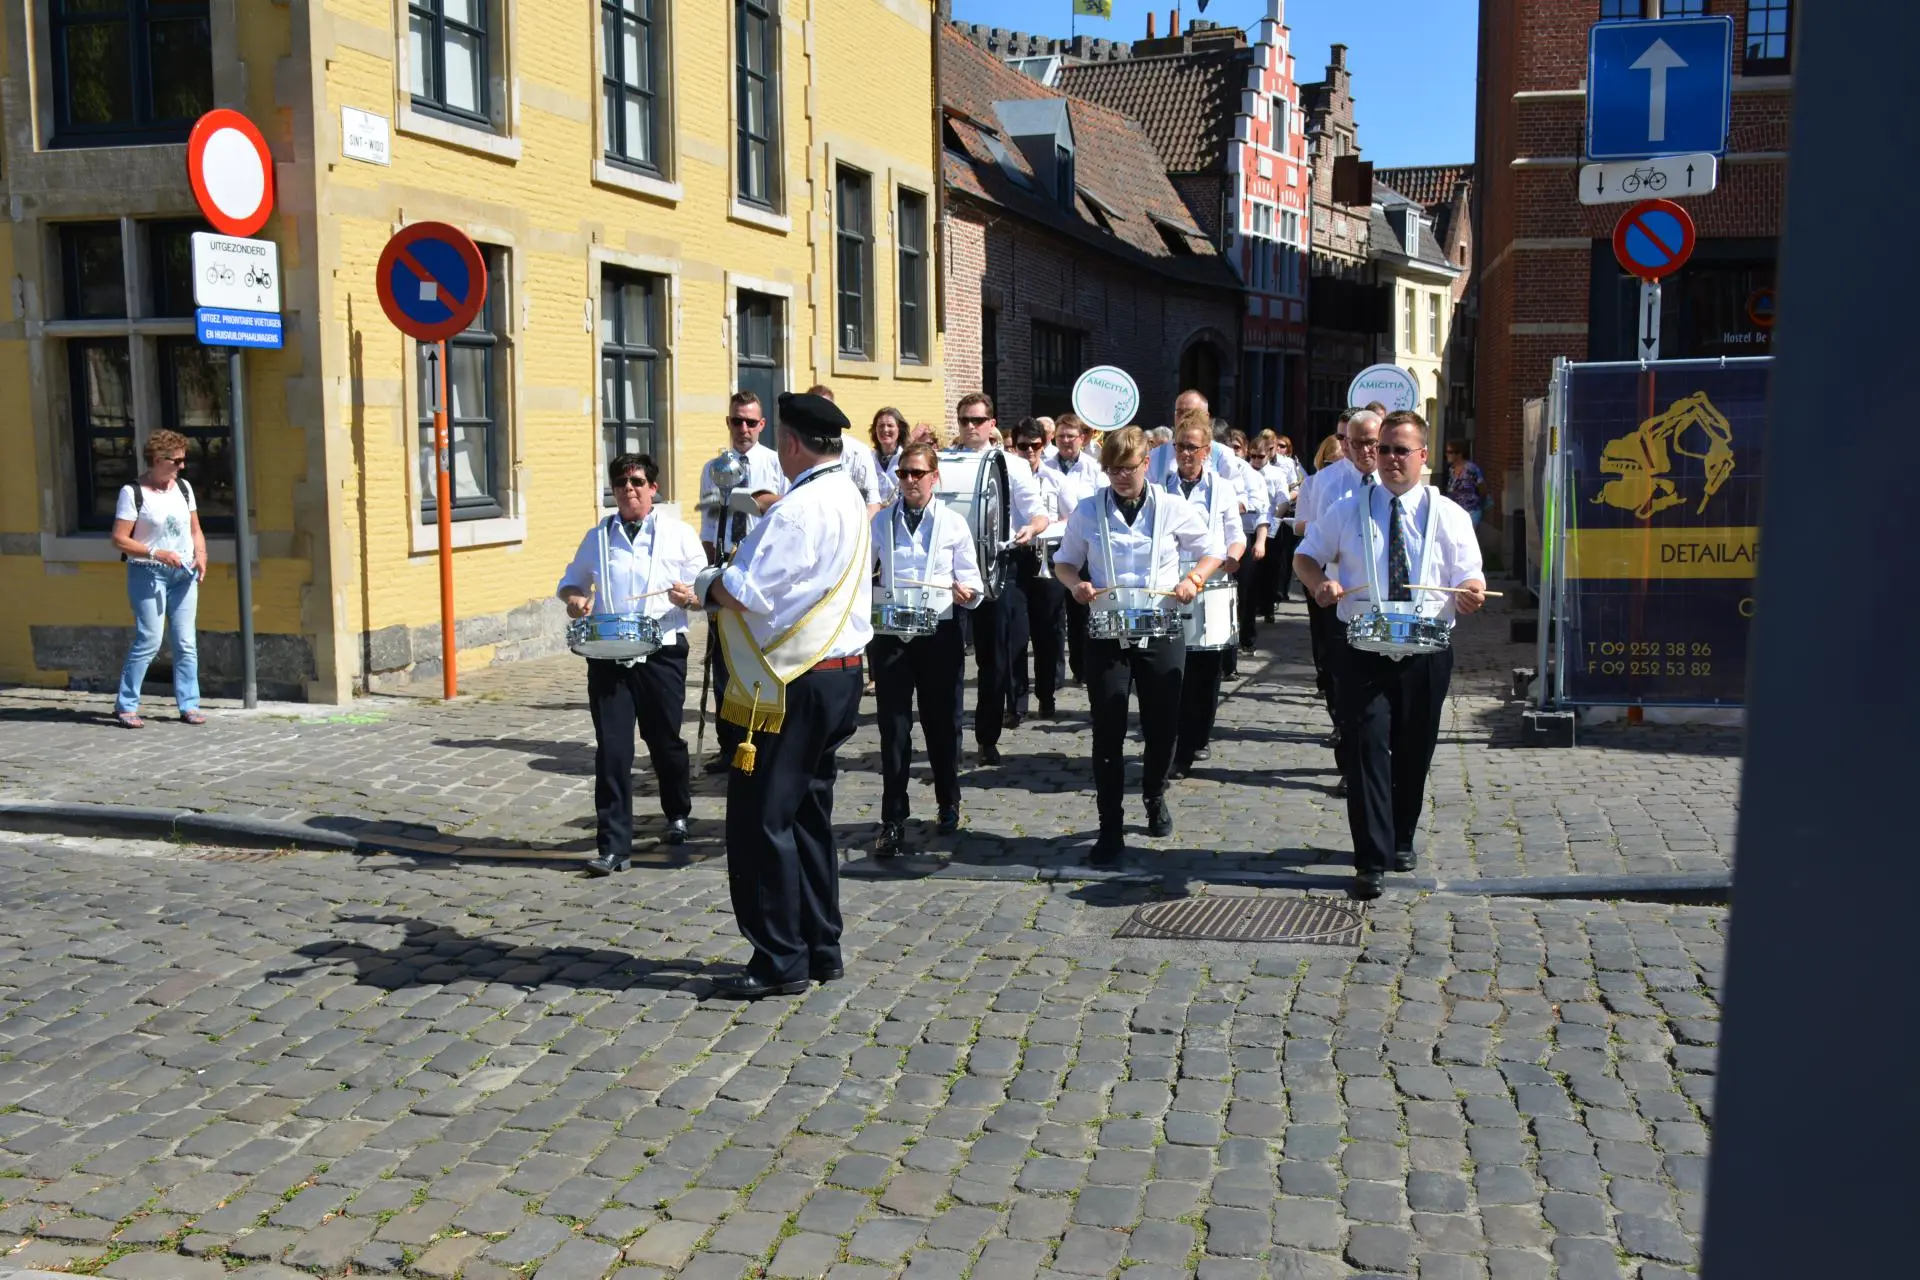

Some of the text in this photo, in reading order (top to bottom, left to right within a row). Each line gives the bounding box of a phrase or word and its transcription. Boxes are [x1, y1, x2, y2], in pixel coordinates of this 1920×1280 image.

[210, 241, 266, 256] UITGEZONDERD
[256, 295, 262, 303] A
[206, 329, 215, 339] EN
[1087, 376, 1128, 393] AMICITIA
[1359, 381, 1404, 389] AMICITIA
[1588, 642, 1597, 655] T
[1630, 642, 1660, 656] 252
[1665, 642, 1686, 656] 38
[1691, 642, 1712, 656] 26
[1588, 661, 1597, 674] F
[1630, 661, 1660, 675] 252
[1666, 661, 1686, 676] 53
[1691, 661, 1712, 676] 82
